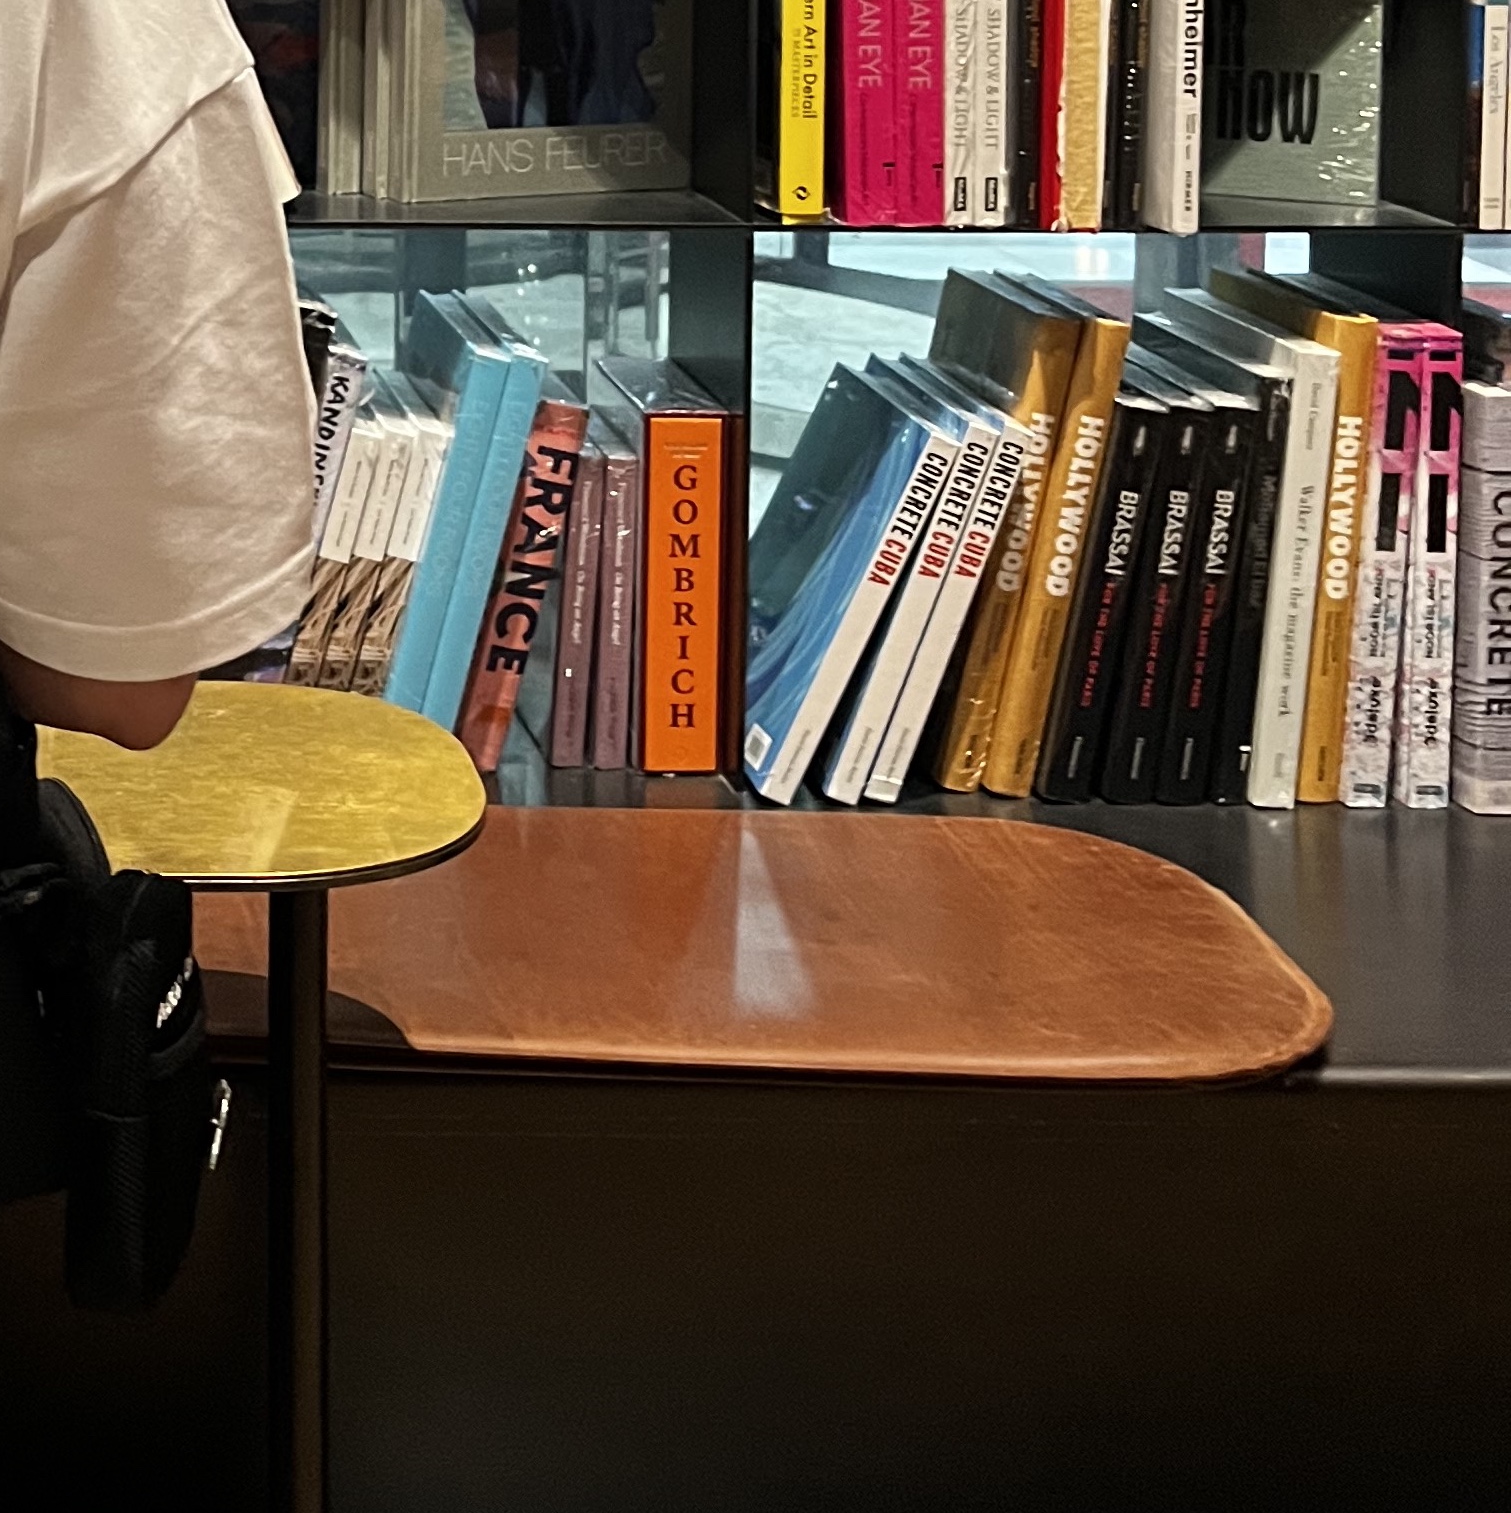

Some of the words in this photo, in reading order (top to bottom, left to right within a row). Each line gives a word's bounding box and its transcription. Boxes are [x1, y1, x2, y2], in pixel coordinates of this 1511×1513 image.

[804, 23, 819, 48] Art
[804, 53, 817, 69] in
[858, 45, 883, 88] EYE
[908, 47, 930, 89] EYE
[802, 73, 817, 119] Detail
[443, 138, 533, 177] HANS
[891, 452, 948, 541] CONCRETE
[939, 442, 989, 532] CONCRETE
[1046, 416, 1105, 598] HOLLYWOOD
[1295, 485, 1315, 531] Walker
[486, 445, 580, 675] FRANCE
[867, 539, 908, 586] CUBA
[917, 531, 954, 580] CUBA
[668, 464, 701, 729] GOMBRICH
[1288, 586, 1304, 609] the
[1280, 614, 1299, 678] magazine
[1277, 685, 1294, 717] work
